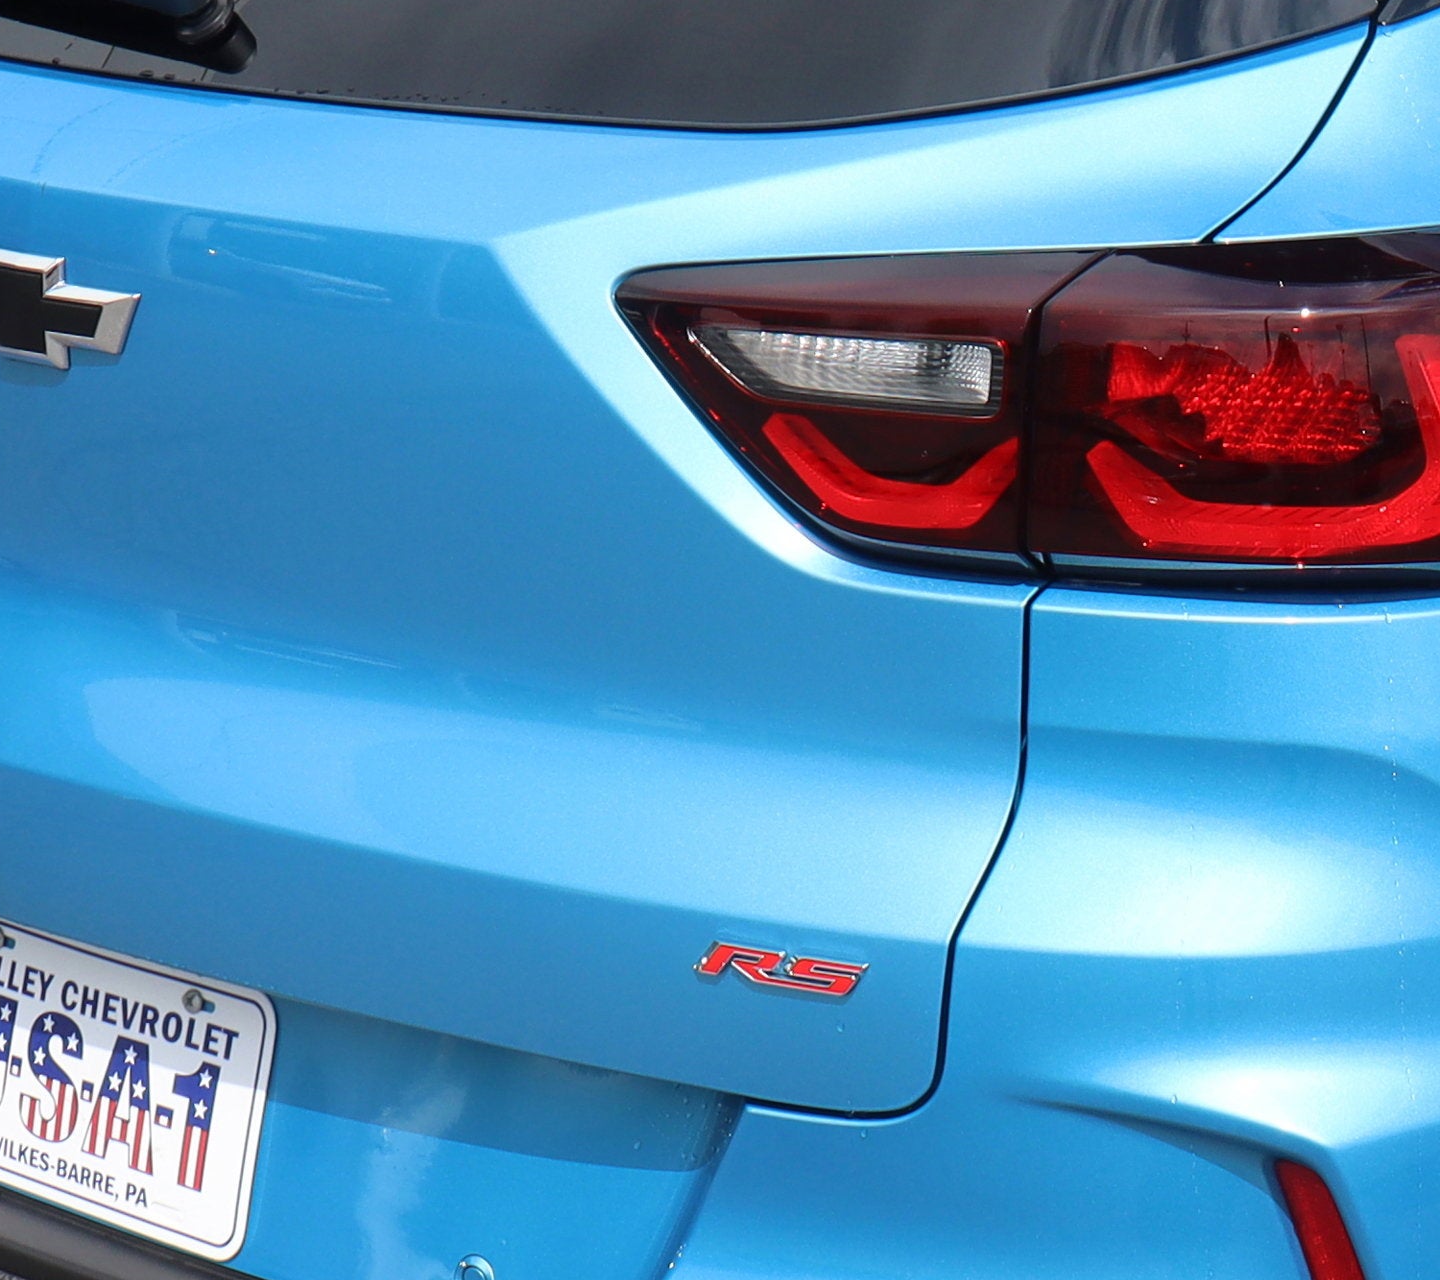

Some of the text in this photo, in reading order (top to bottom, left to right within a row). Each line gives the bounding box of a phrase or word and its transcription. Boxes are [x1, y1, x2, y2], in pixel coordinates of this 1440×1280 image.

[692, 939, 870, 996] RS
[61, 980, 240, 1061] CHEVROLET
[125, 1181, 149, 1209] PA
